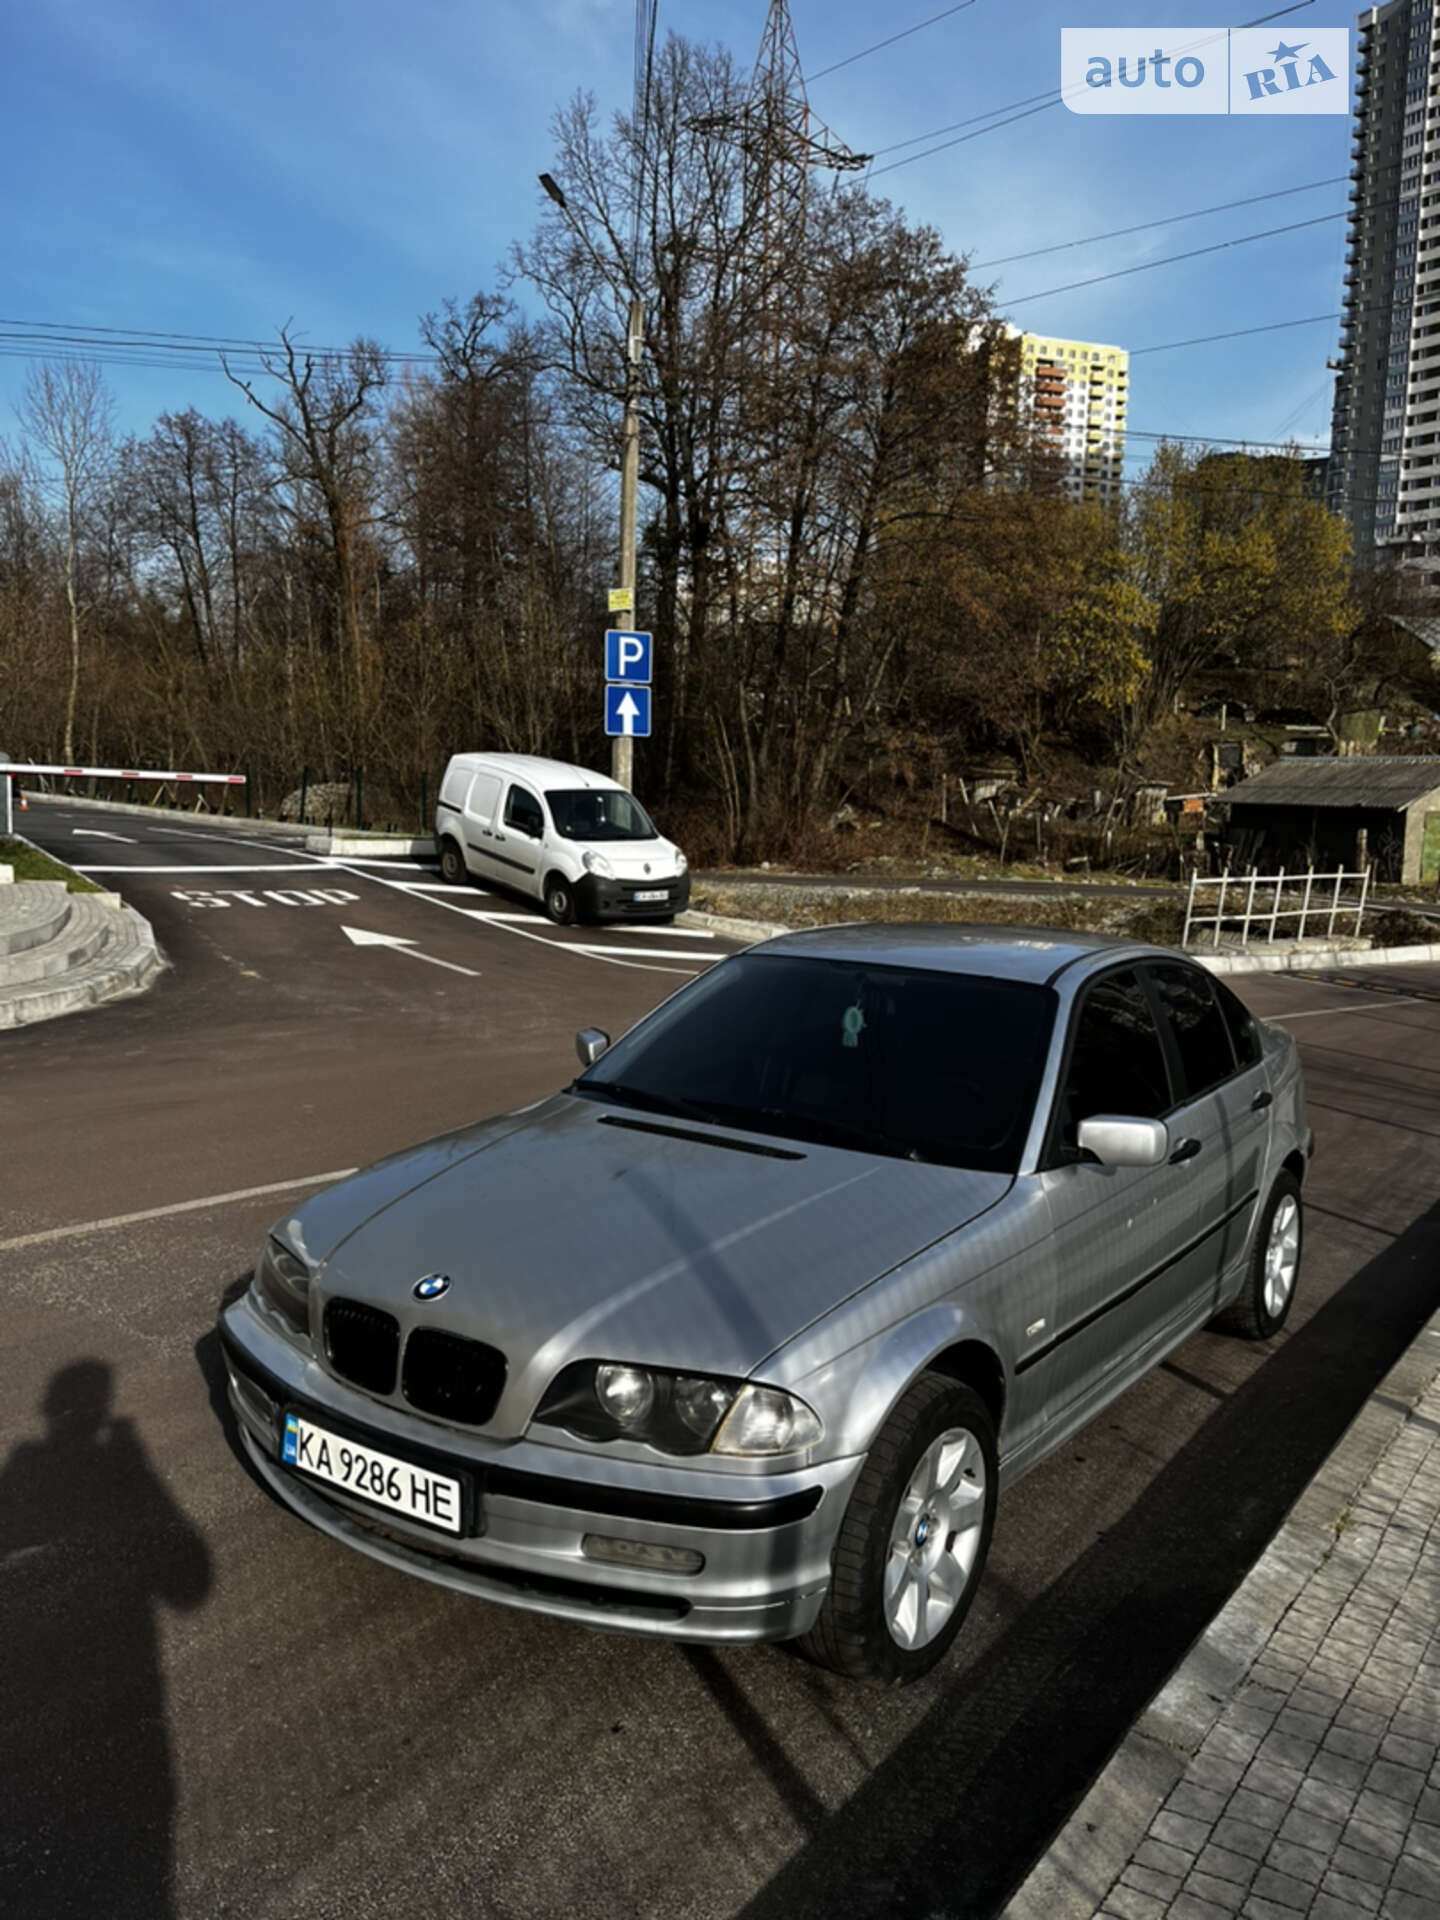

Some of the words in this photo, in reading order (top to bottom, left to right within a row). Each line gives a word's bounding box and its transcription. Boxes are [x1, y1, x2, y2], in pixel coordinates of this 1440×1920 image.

[618, 636, 644, 676] P
[170, 889, 360, 908] STOP
[299, 1427, 333, 1476] KA
[339, 1447, 402, 1501] 9286
[410, 1472, 453, 1522] HE
